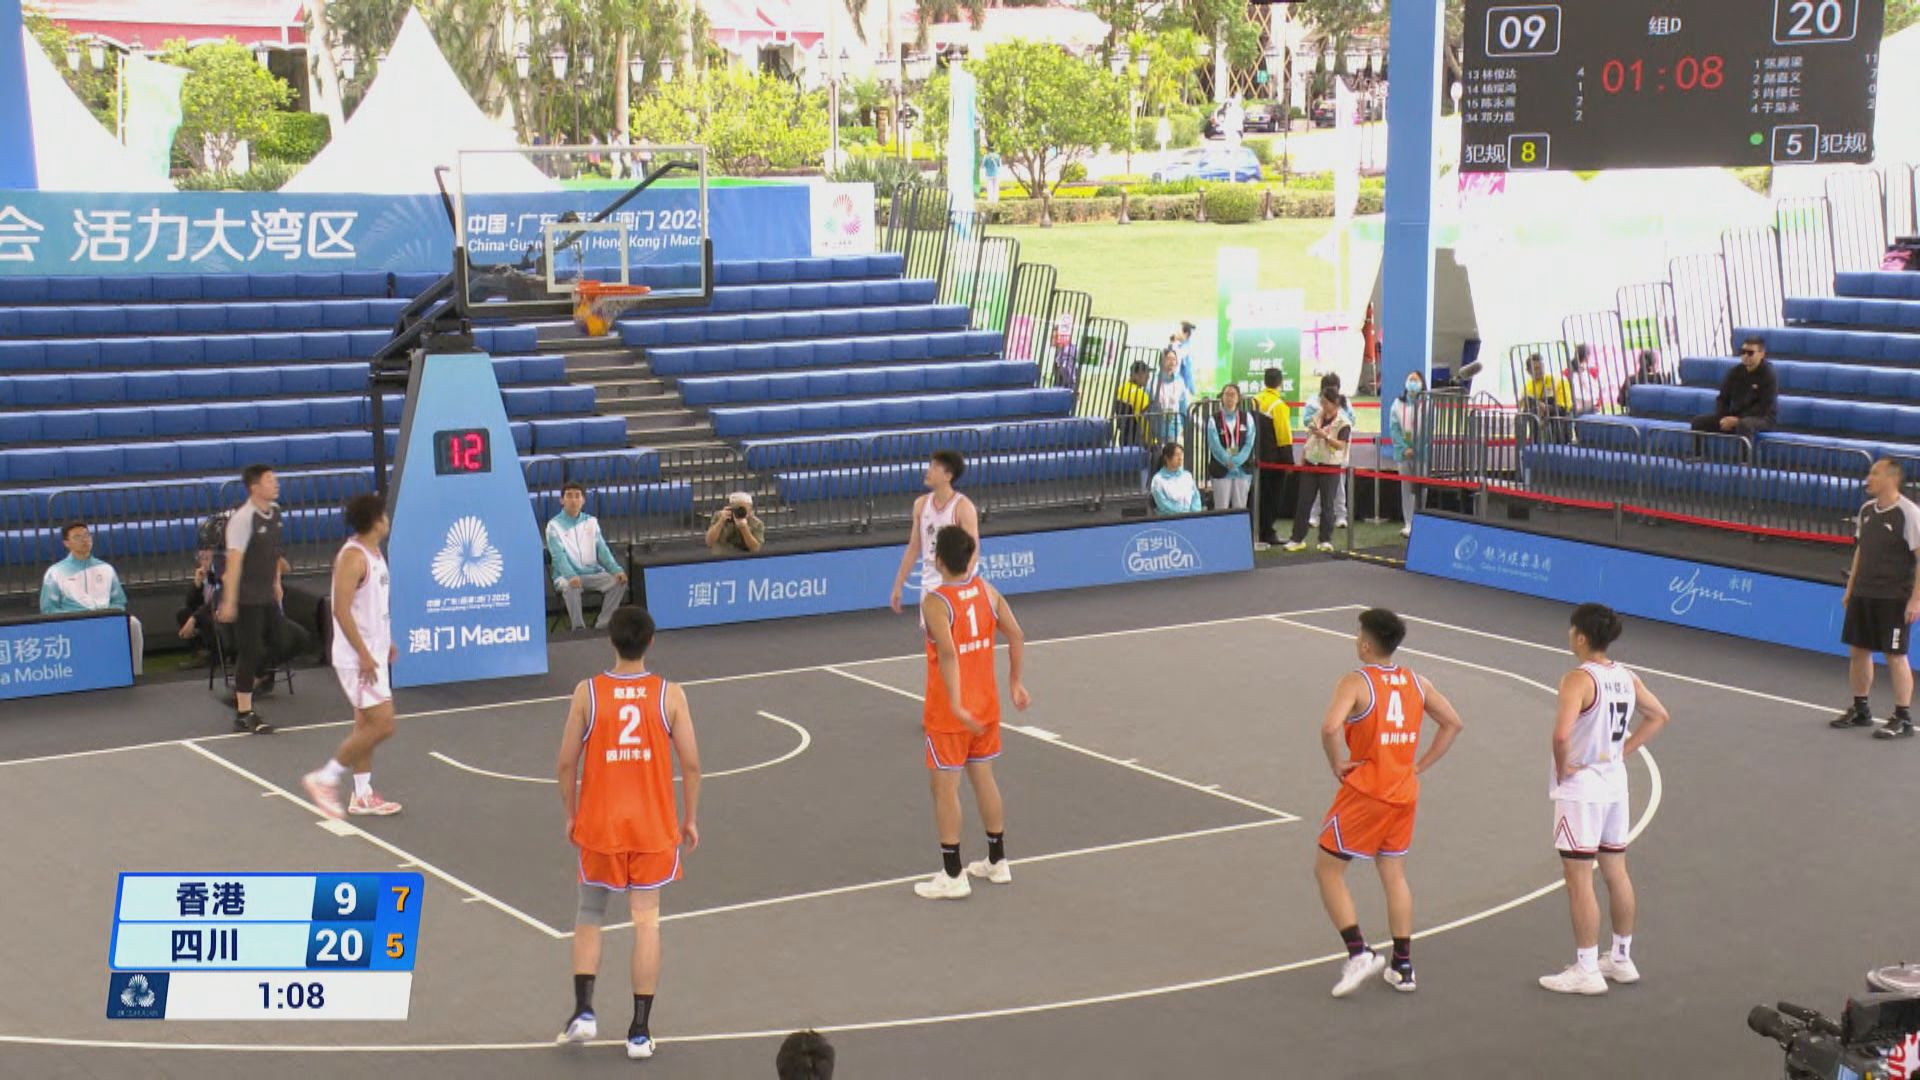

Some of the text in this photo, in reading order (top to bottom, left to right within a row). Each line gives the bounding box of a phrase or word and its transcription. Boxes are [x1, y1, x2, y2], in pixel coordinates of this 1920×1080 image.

[1647, 16, 1682, 35] 组D
[1788, 0, 1842, 36] 20
[1500, 15, 1547, 49] 09
[1468, 70, 1480, 80] 13
[1576, 67, 1585, 77] 4
[1753, 74, 1760, 85] 2
[1467, 84, 1479, 94] 14
[1752, 89, 1760, 99] 3
[1751, 104, 1758, 113] 4
[1465, 142, 1536, 163] 犯规 8
[1786, 133, 1867, 155] 5 犯规
[70, 208, 359, 262] 活力大湾区
[629, 234, 660, 249] Kong
[451, 433, 483, 470] 12
[688, 577, 827, 608] 澳门 Macau
[966, 604, 979, 638] 1
[409, 624, 530, 653] 澳门 Macau
[15, 662, 73, 683] Mobile
[1386, 690, 1405, 729] 4
[1609, 702, 1628, 742] 13
[619, 704, 641, 745] 2
